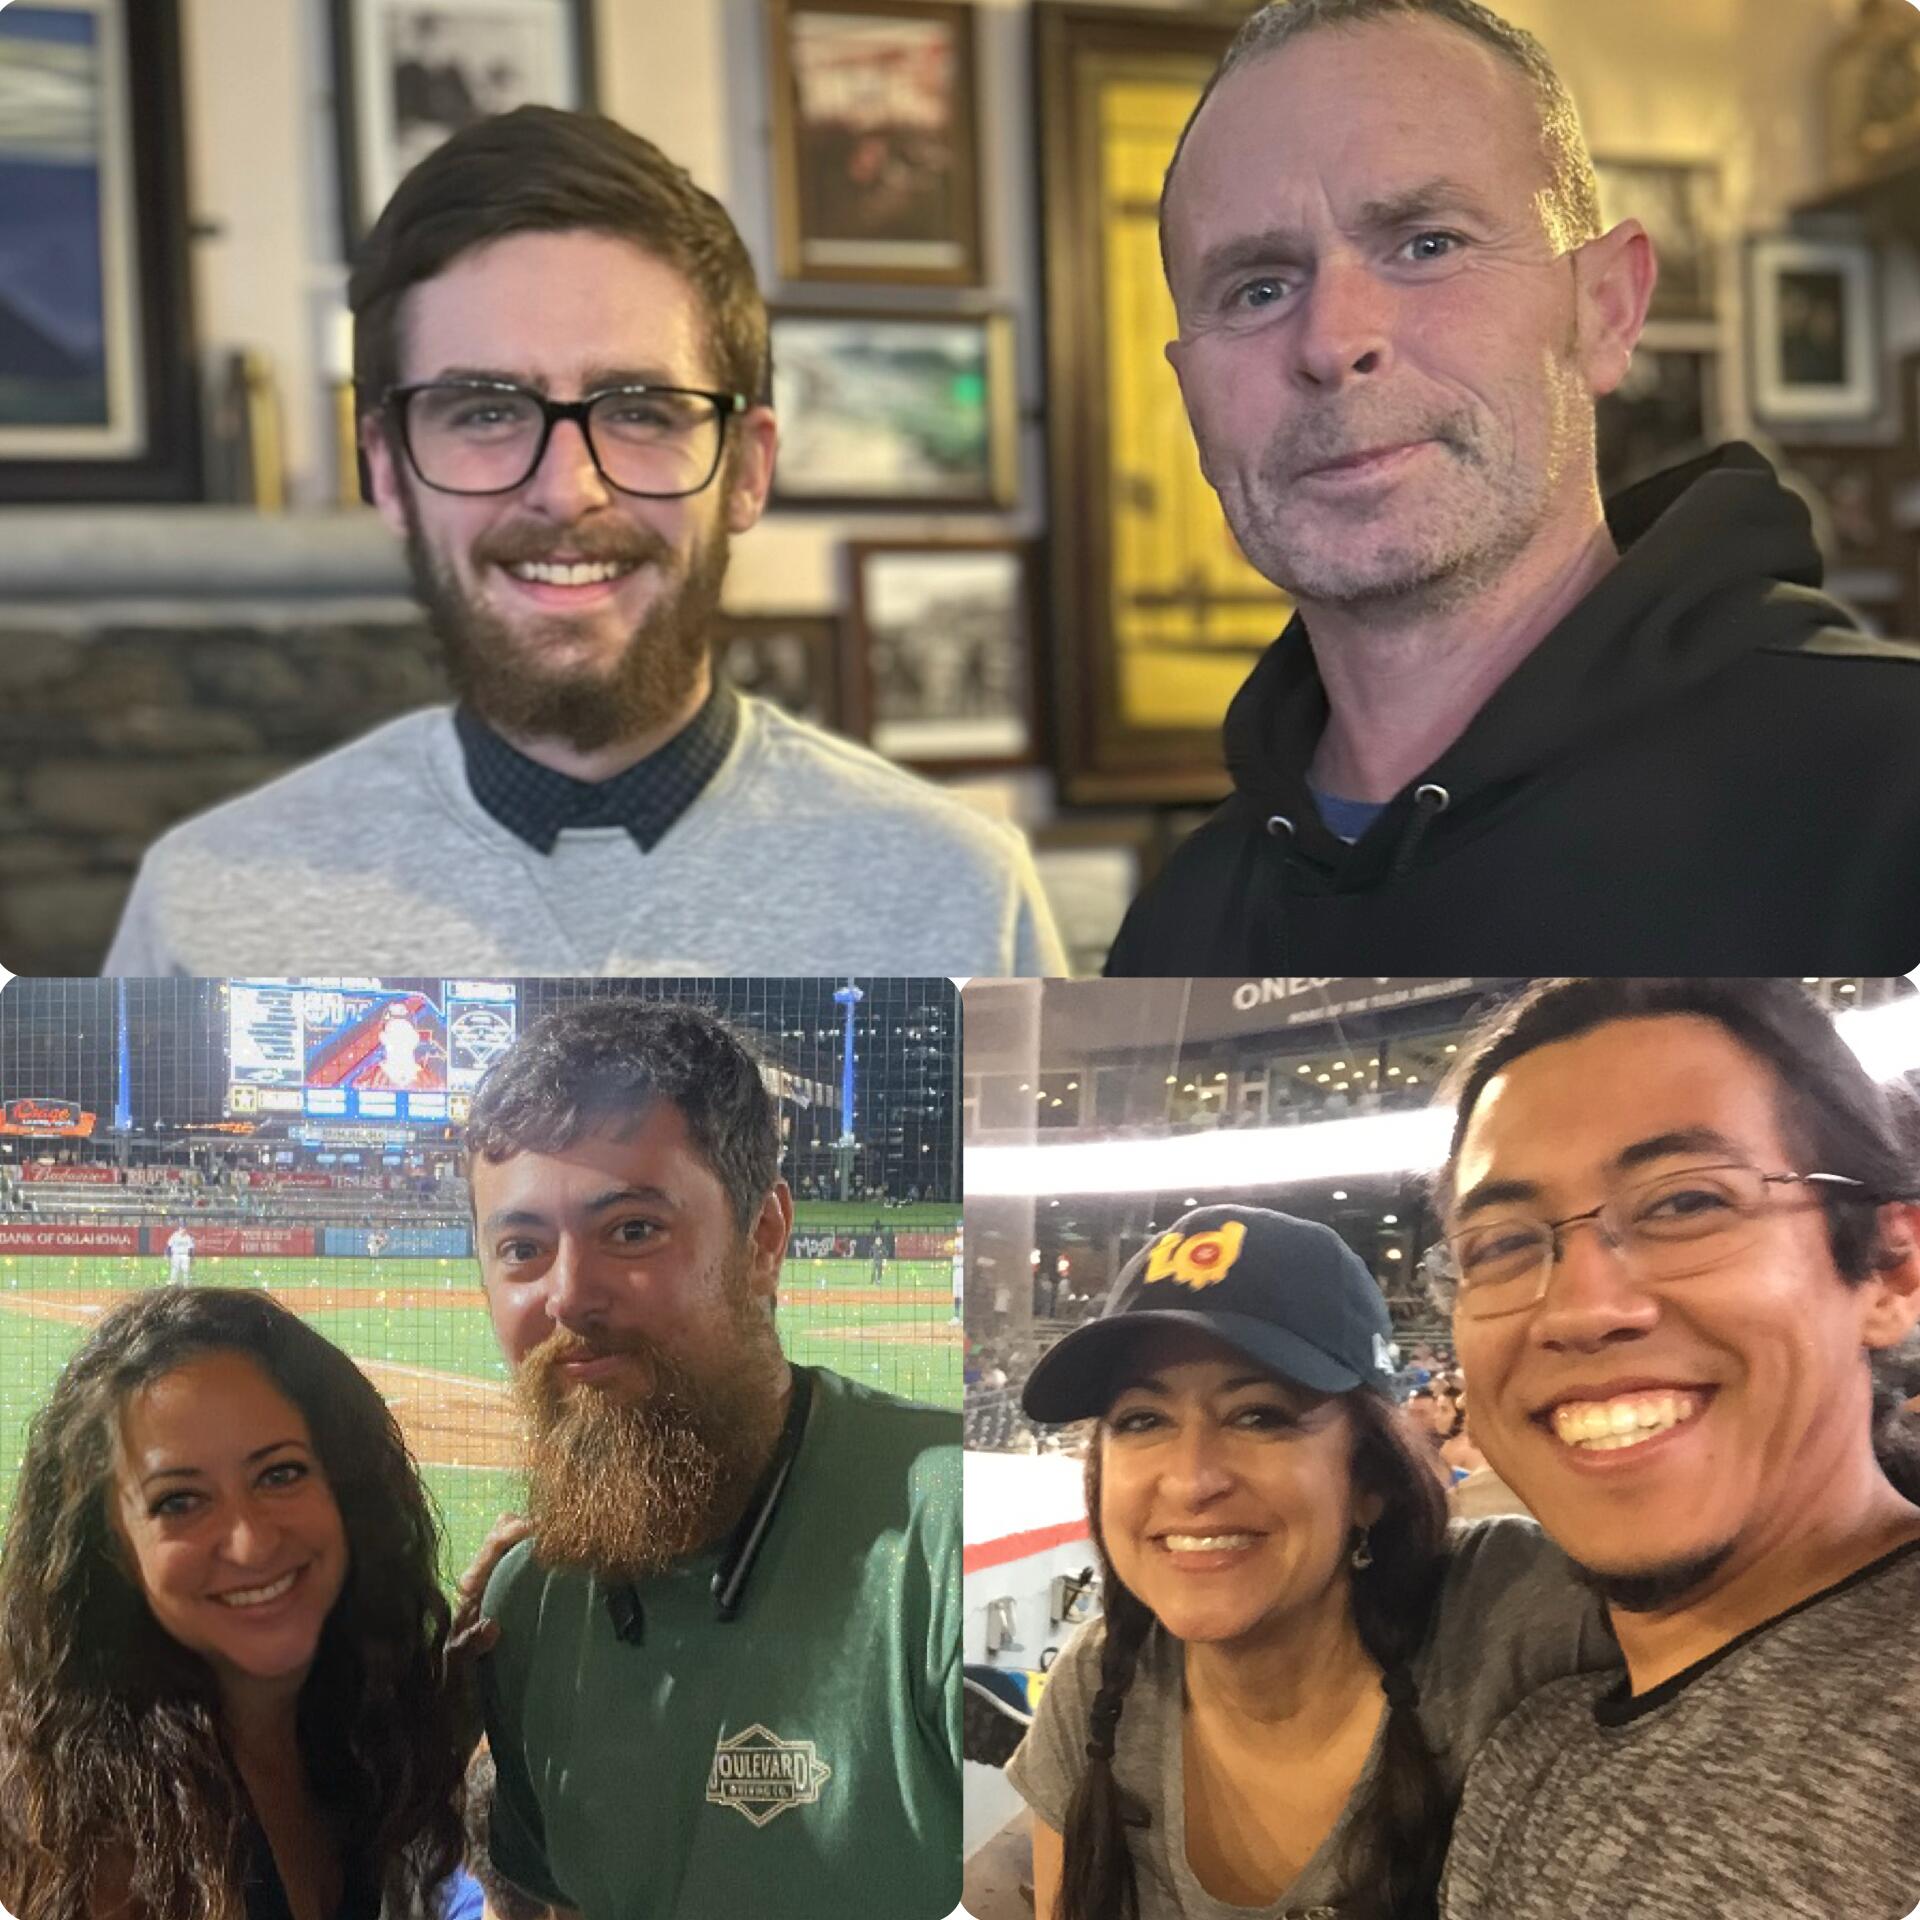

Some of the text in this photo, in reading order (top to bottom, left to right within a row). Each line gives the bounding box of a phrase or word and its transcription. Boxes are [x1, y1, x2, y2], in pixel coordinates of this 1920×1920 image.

[0, 1232, 131, 1246] BANK OF OKLAHOMA
